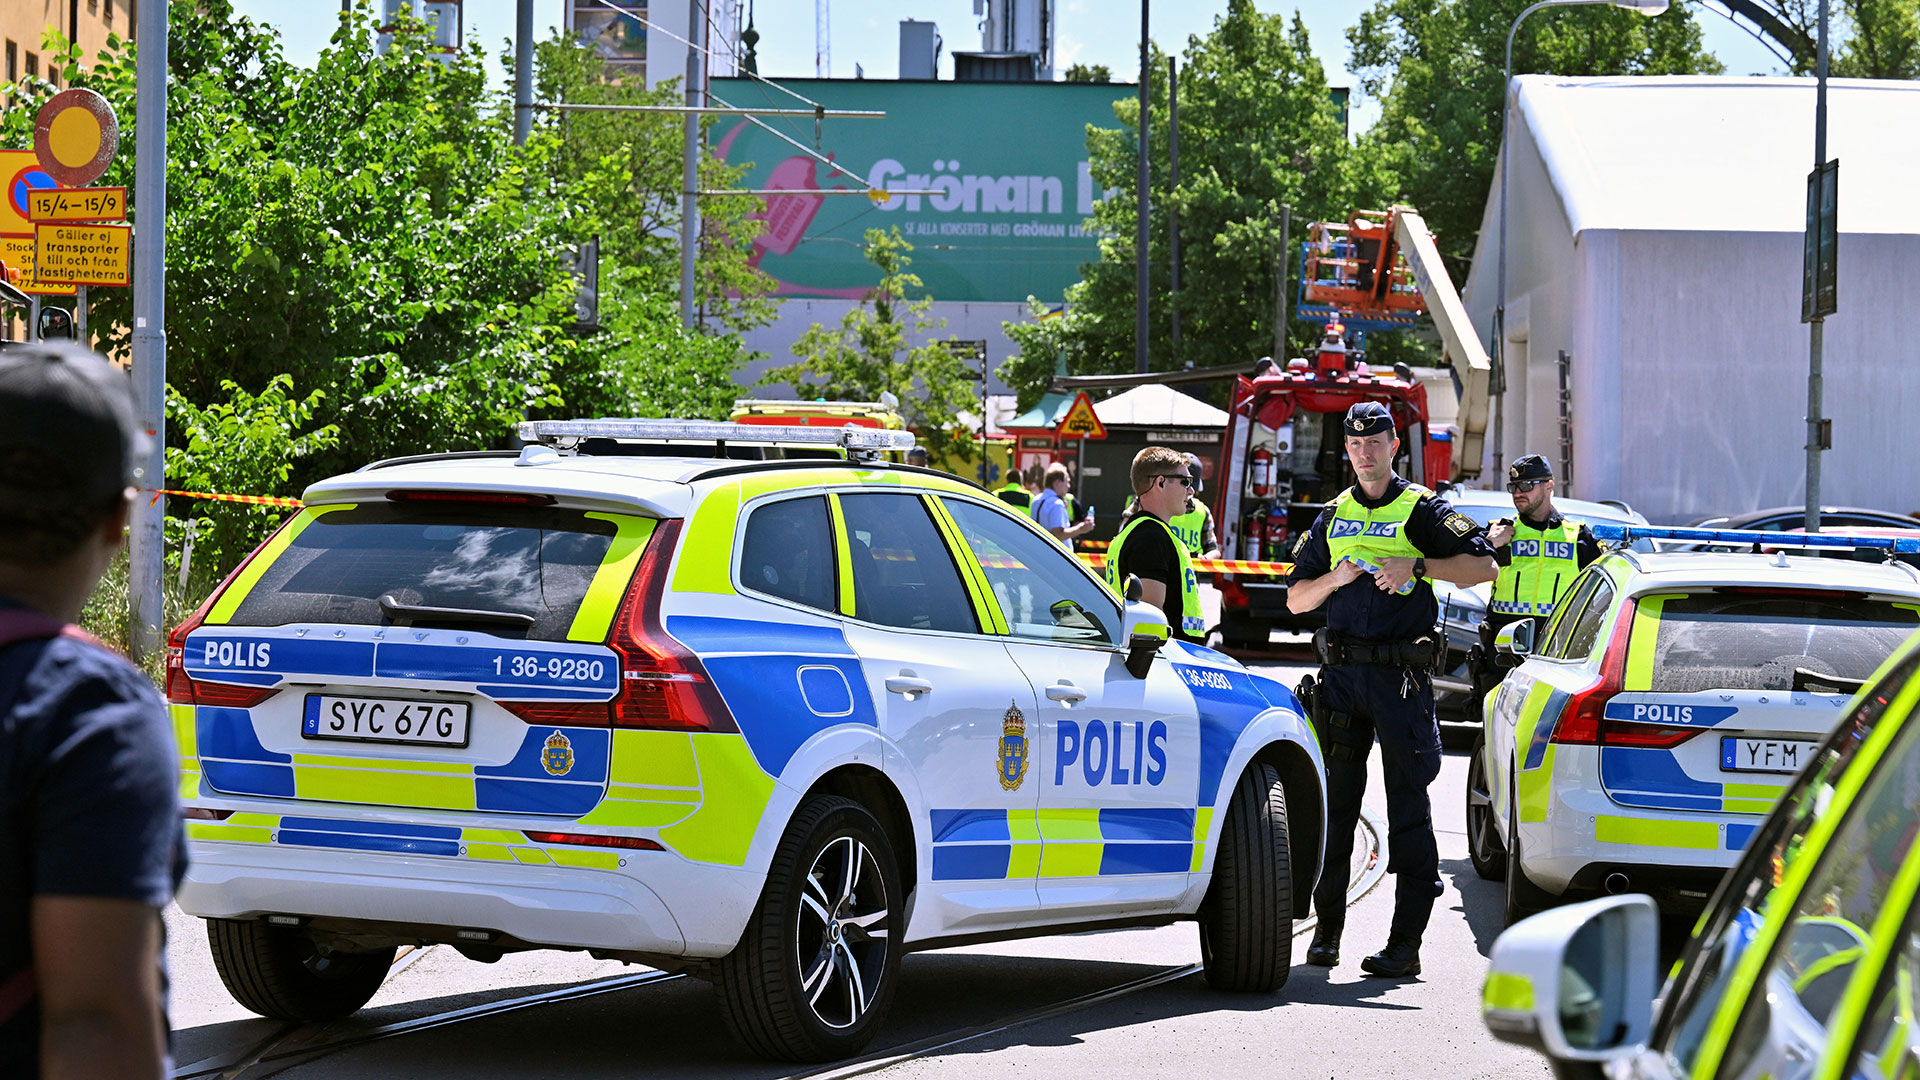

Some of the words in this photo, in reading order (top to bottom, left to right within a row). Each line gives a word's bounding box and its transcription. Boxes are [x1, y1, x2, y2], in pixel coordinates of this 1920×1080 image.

[867, 158, 1064, 214] Grönan
[56, 229, 94, 241] Gäller
[100, 231, 111, 243] ej
[905, 222, 914, 236] SE
[917, 222, 938, 236] ALLA
[940, 222, 989, 236] KONSERTER
[991, 223, 1010, 236] MED
[1013, 220, 1065, 237] GRÖNAN
[46, 242, 119, 255] transporter
[47, 254, 63, 265] till
[67, 256, 88, 266] och
[93, 256, 118, 267] från
[40, 267, 125, 280] fastigheterna
[1516, 540, 1569, 558] POLIS
[204, 641, 271, 668] POLIS
[493, 655, 502, 675] 1
[510, 656, 604, 681] 36-9280
[1178, 668, 1190, 686] 1
[1185, 668, 1233, 690] 36-9280
[308, 719, 315, 728] S
[329, 701, 386, 734] SYC
[394, 704, 454, 738] 67G
[1633, 704, 1693, 724] POLIS
[1054, 719, 1168, 787] POLIS
[1746, 742, 1797, 767] YFM
